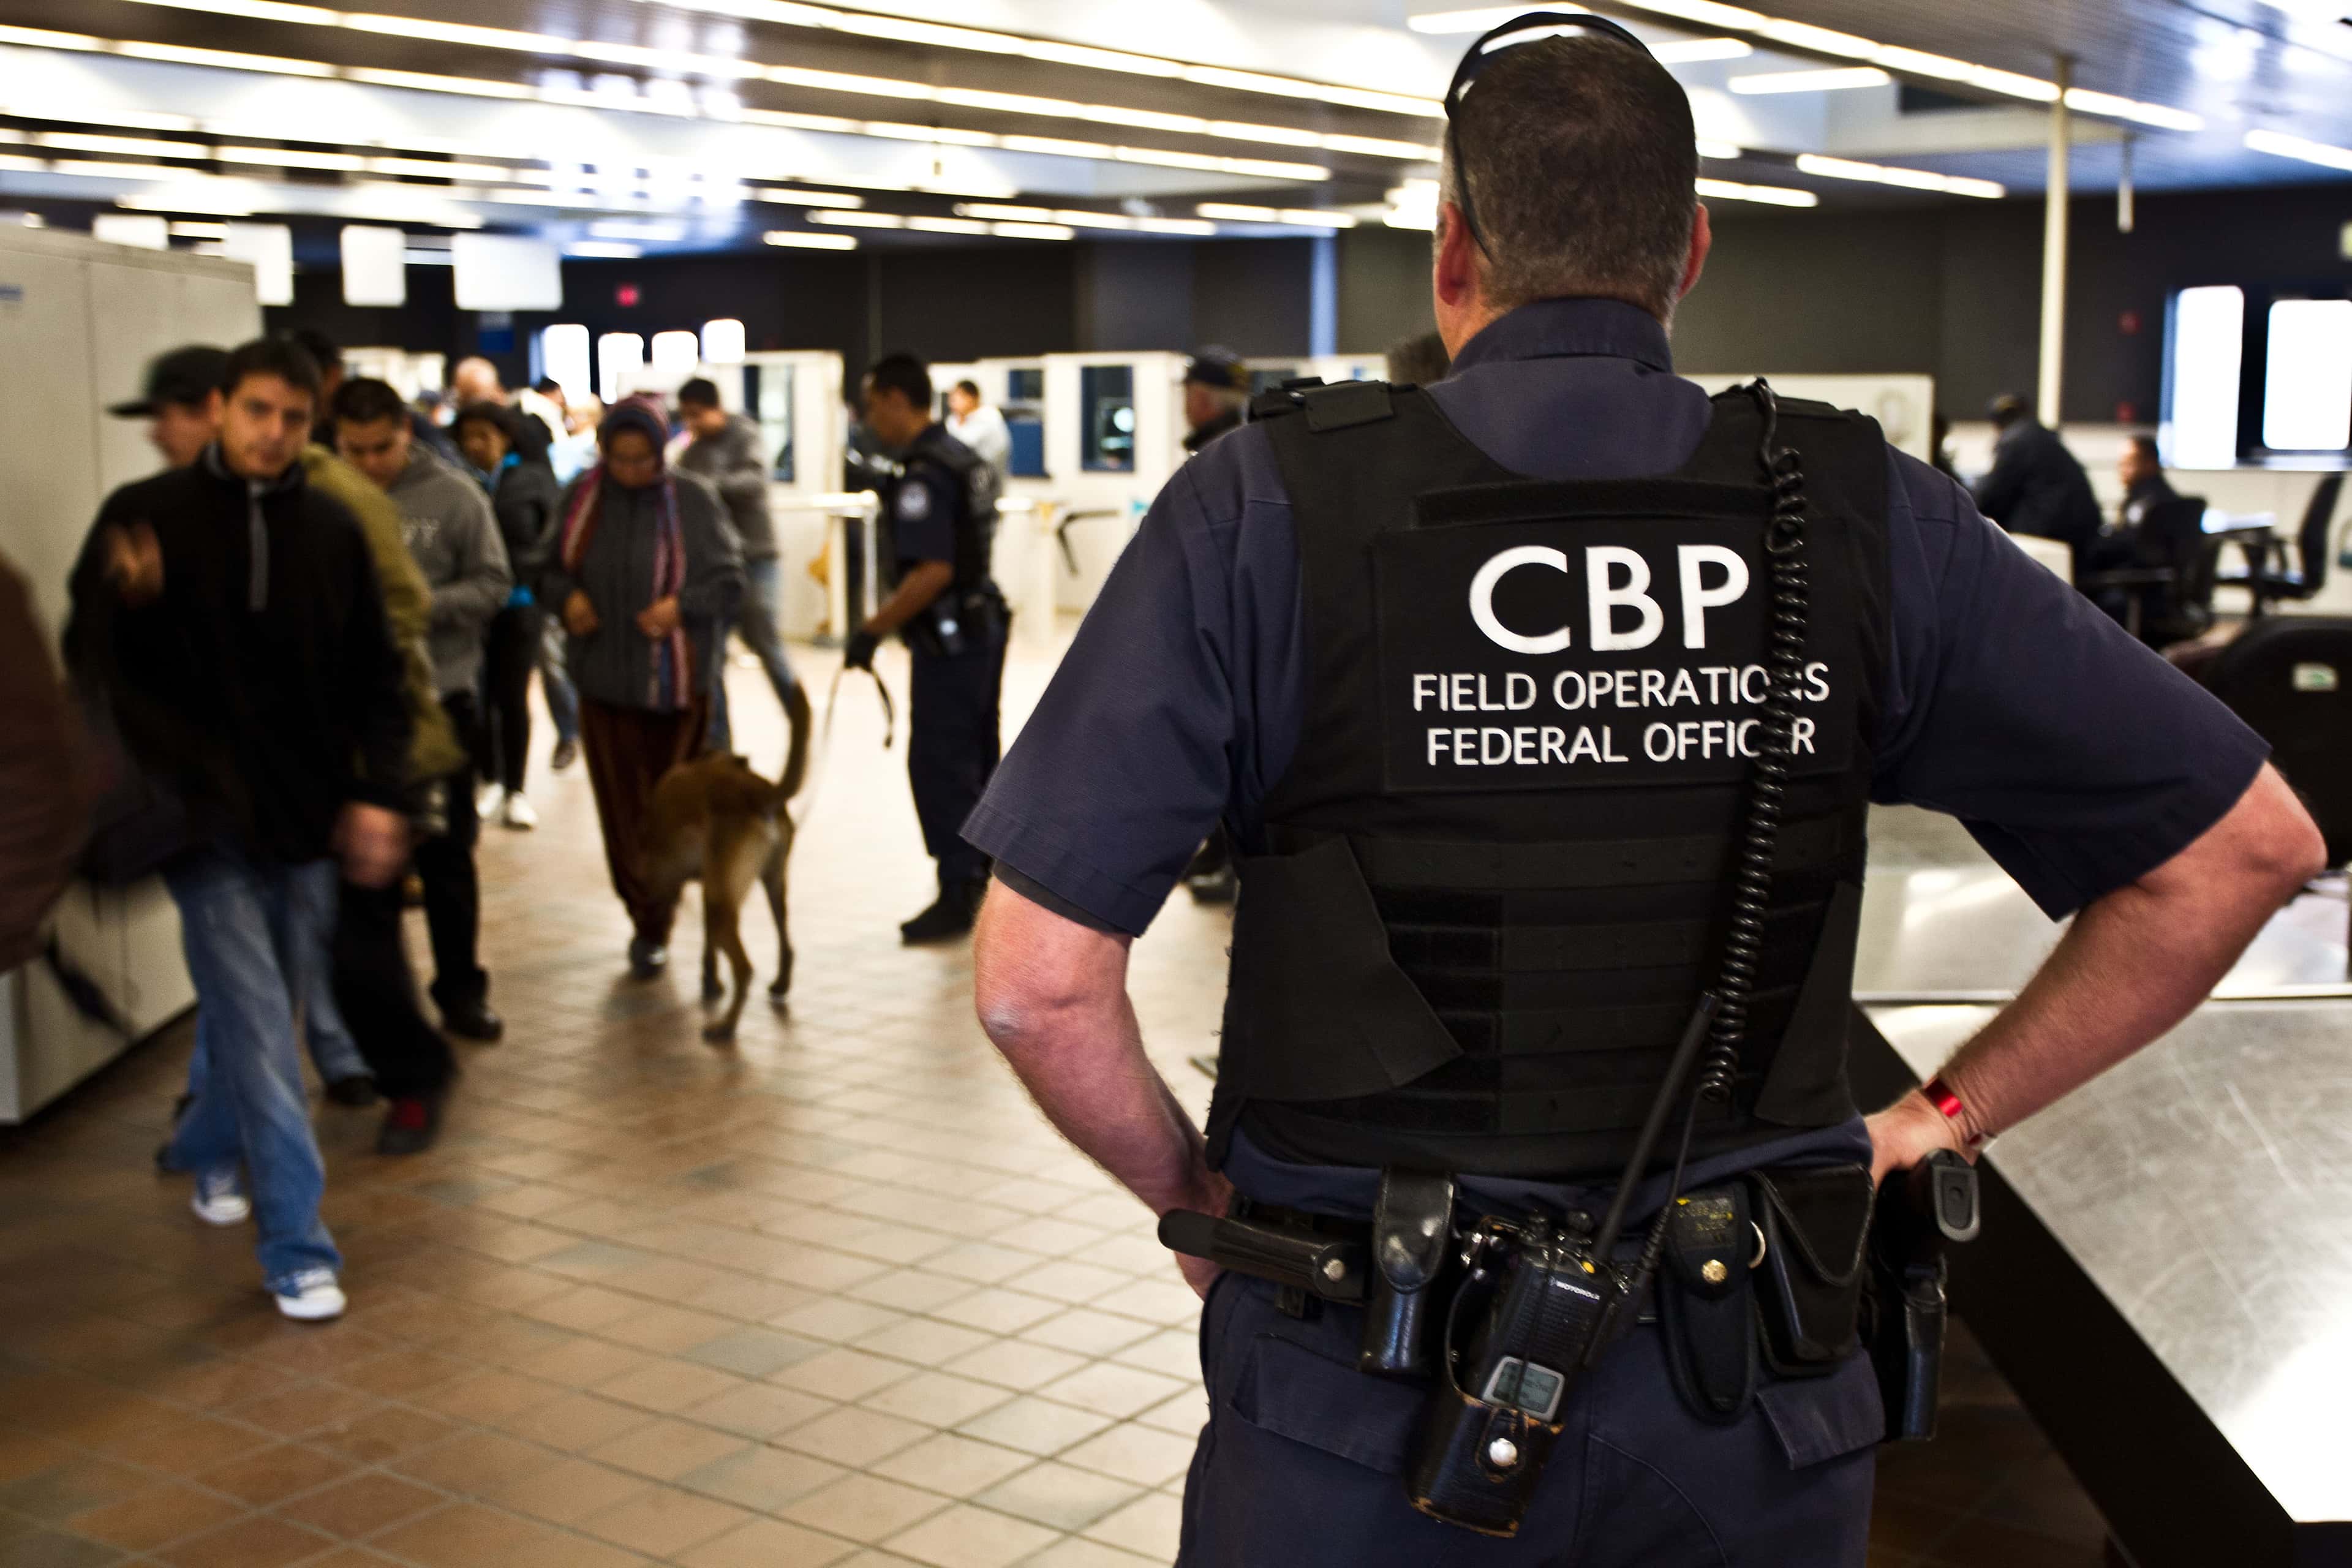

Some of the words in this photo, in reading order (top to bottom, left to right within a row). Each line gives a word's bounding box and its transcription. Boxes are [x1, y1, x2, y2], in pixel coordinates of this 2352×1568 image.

[1469, 545, 1750, 655] CBP
[1413, 672, 1538, 712] FIELD
[1552, 662, 1830, 711] OPERATIOS
[1427, 725, 1630, 766] FEDERAL
[1643, 717, 1816, 763] OFFICR
